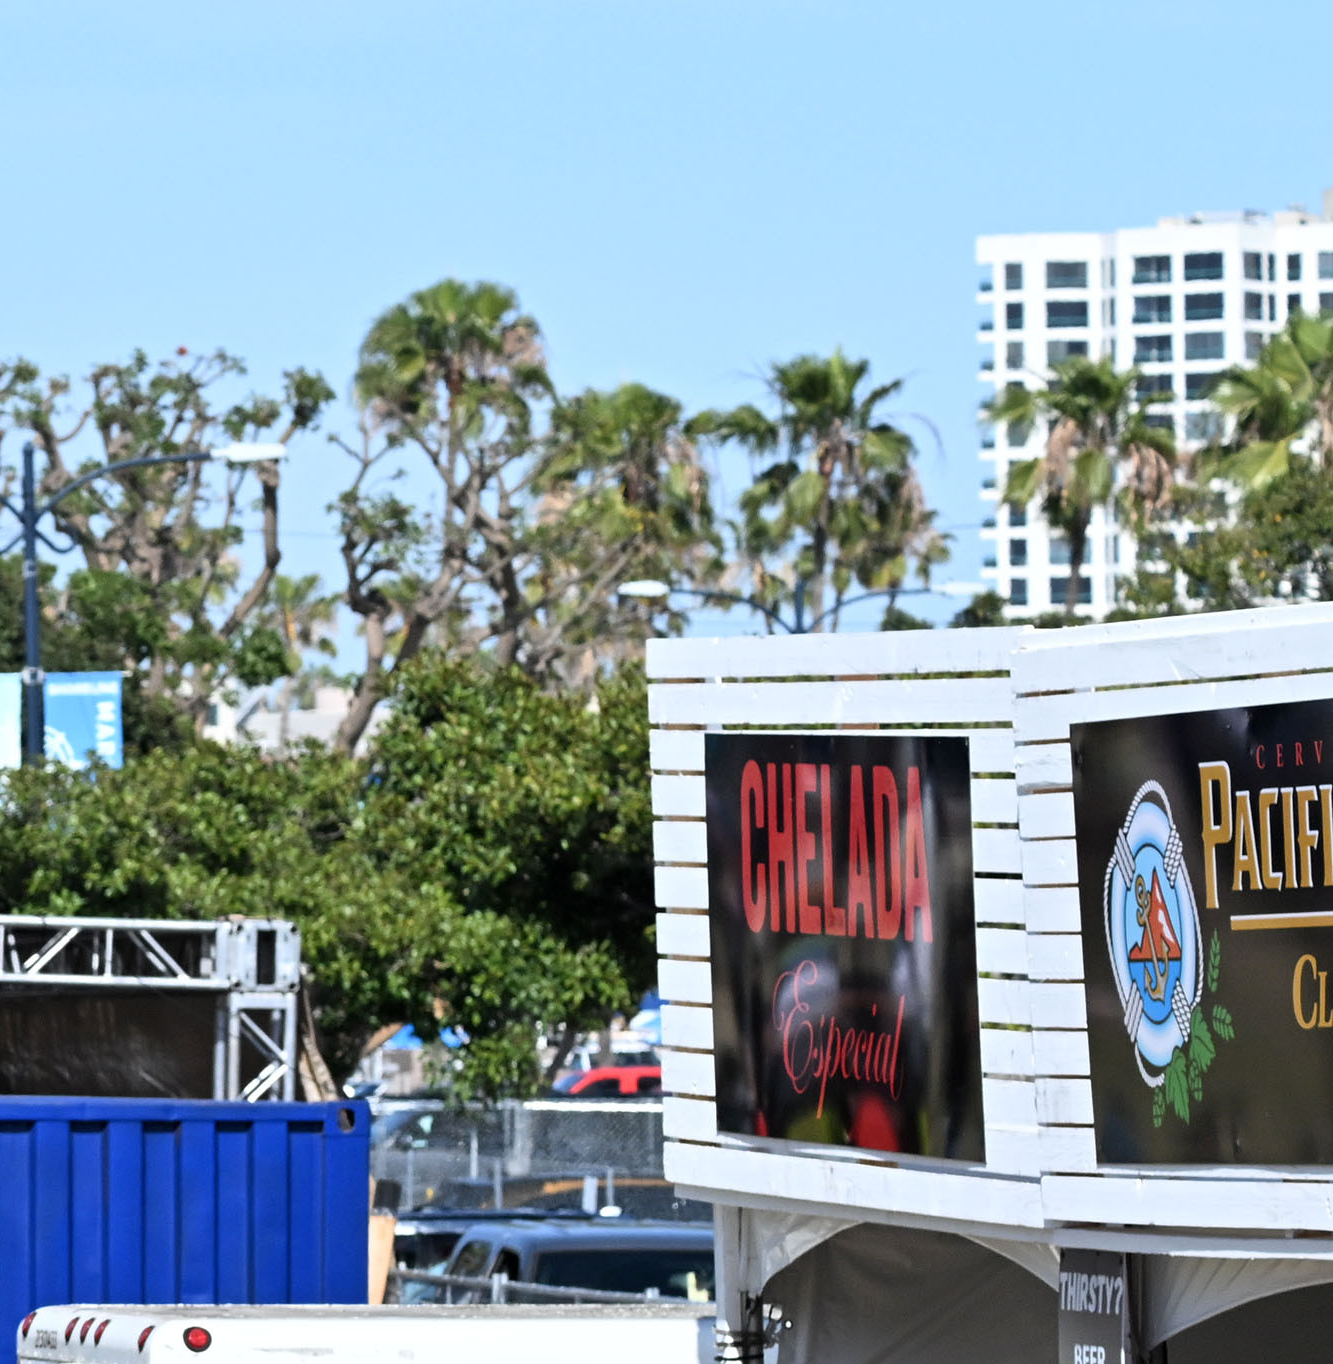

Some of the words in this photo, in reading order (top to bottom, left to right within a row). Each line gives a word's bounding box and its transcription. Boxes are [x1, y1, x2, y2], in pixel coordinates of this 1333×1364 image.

[1255, 740, 1324, 770] CERV
[740, 760, 933, 943] CHELADA
[1198, 760, 1333, 909] PACIFI
[772, 960, 905, 1119] Especial
[1060, 1272, 1123, 1315] THIRSTY?
